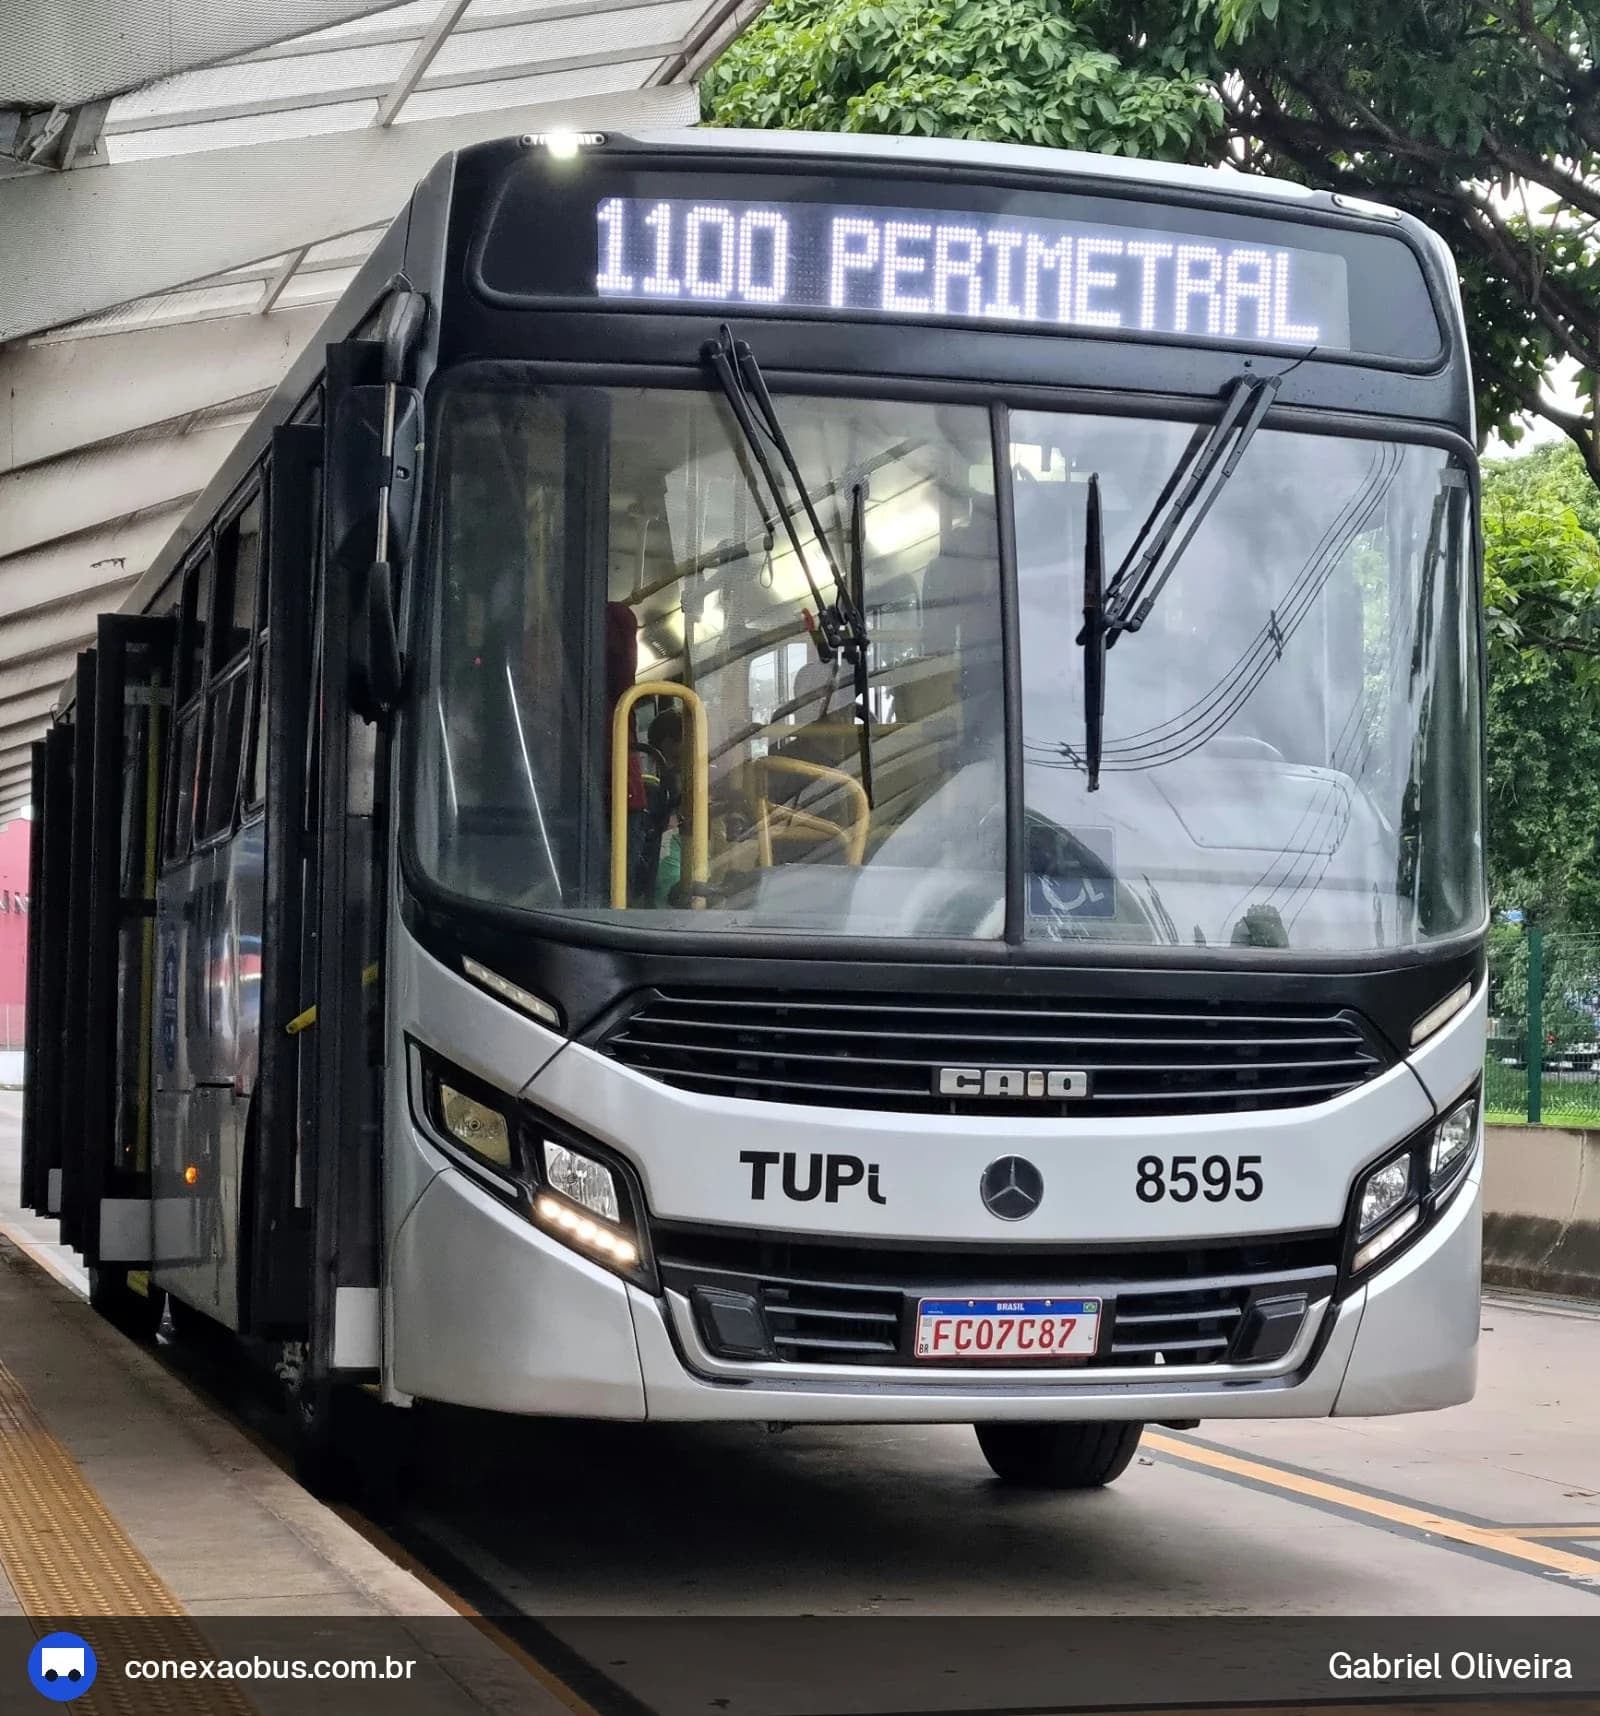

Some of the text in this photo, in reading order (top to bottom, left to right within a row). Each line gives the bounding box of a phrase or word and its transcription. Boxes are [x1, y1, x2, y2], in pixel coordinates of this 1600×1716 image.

[596, 198, 1319, 342] 1100 PERIMETRAL
[1135, 1155, 1264, 1203] 8595
[996, 1302, 1025, 1312] BRASIL
[919, 1344, 929, 1354] BR
